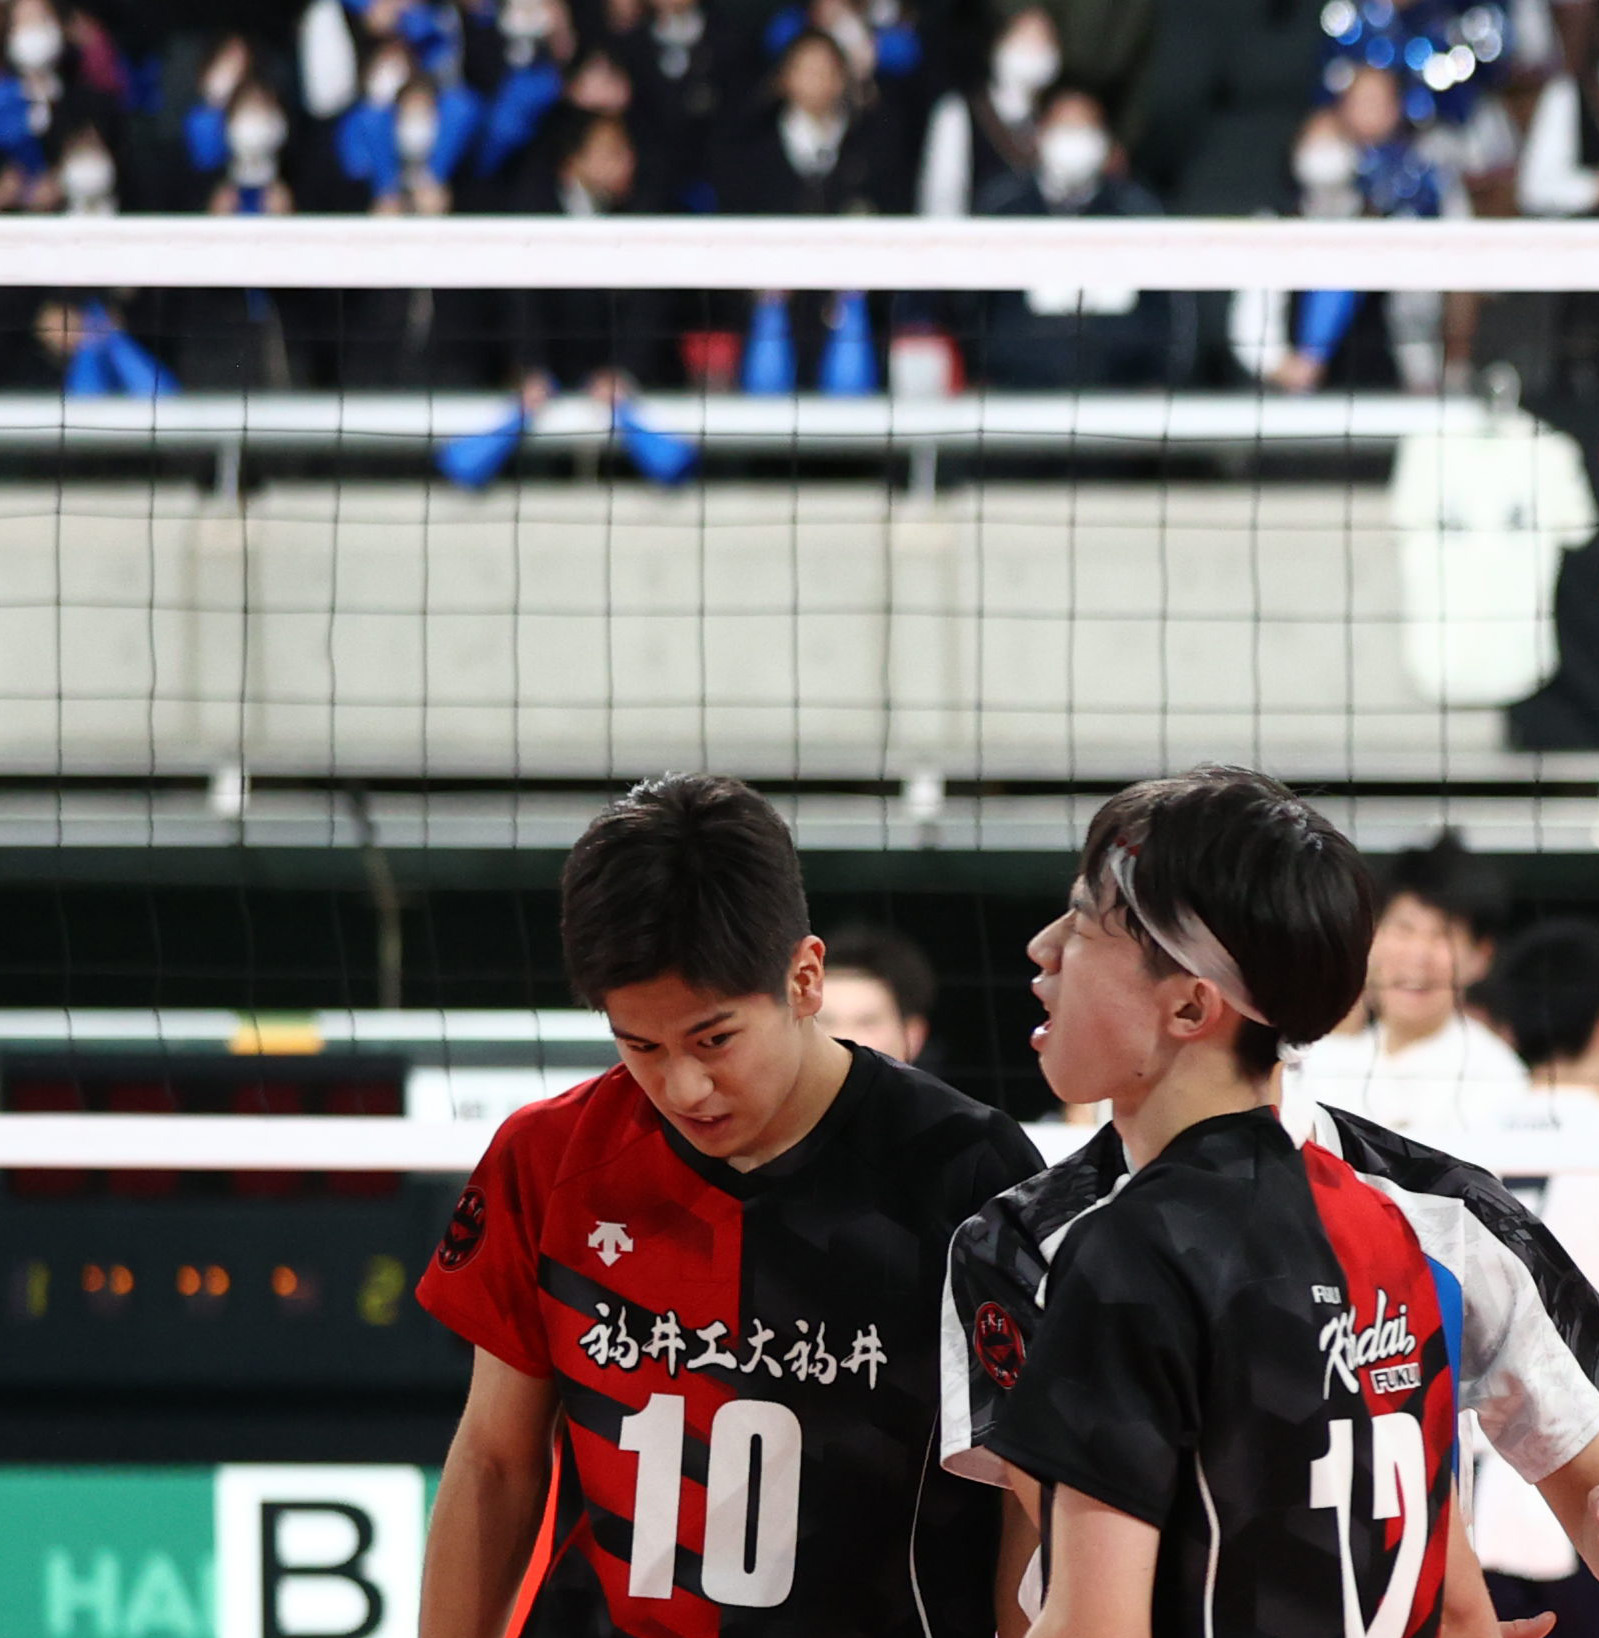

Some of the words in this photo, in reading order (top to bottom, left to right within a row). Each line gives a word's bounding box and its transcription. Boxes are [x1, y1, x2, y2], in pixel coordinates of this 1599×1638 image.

[580, 1302, 888, 1390] 福井工大福井
[618, 1392, 802, 1608] 10
